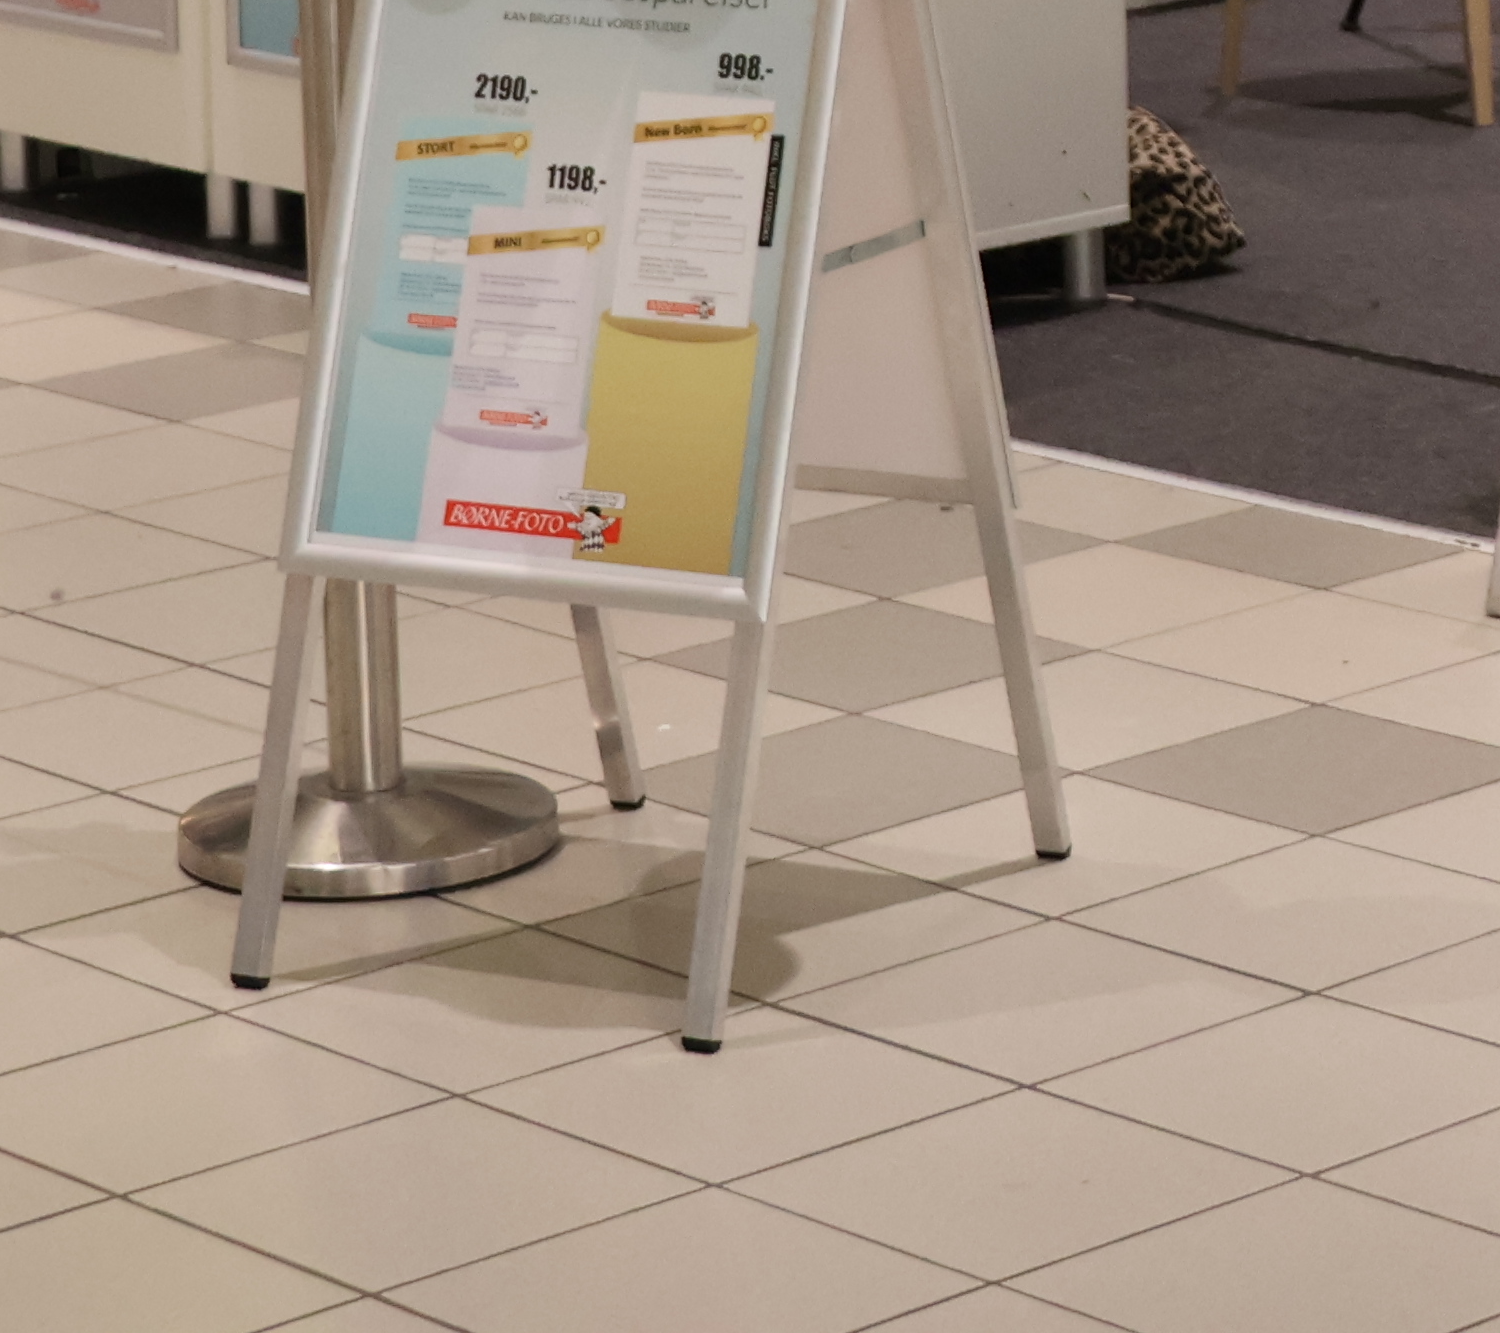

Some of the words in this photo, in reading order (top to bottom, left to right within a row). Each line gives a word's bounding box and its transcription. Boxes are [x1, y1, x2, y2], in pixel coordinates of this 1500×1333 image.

[473, 72, 538, 104] 2190,-
[546, 163, 607, 195] 1198,-
[492, 235, 523, 250] MINI
[448, 502, 566, 536] BØRNE-FOTO
